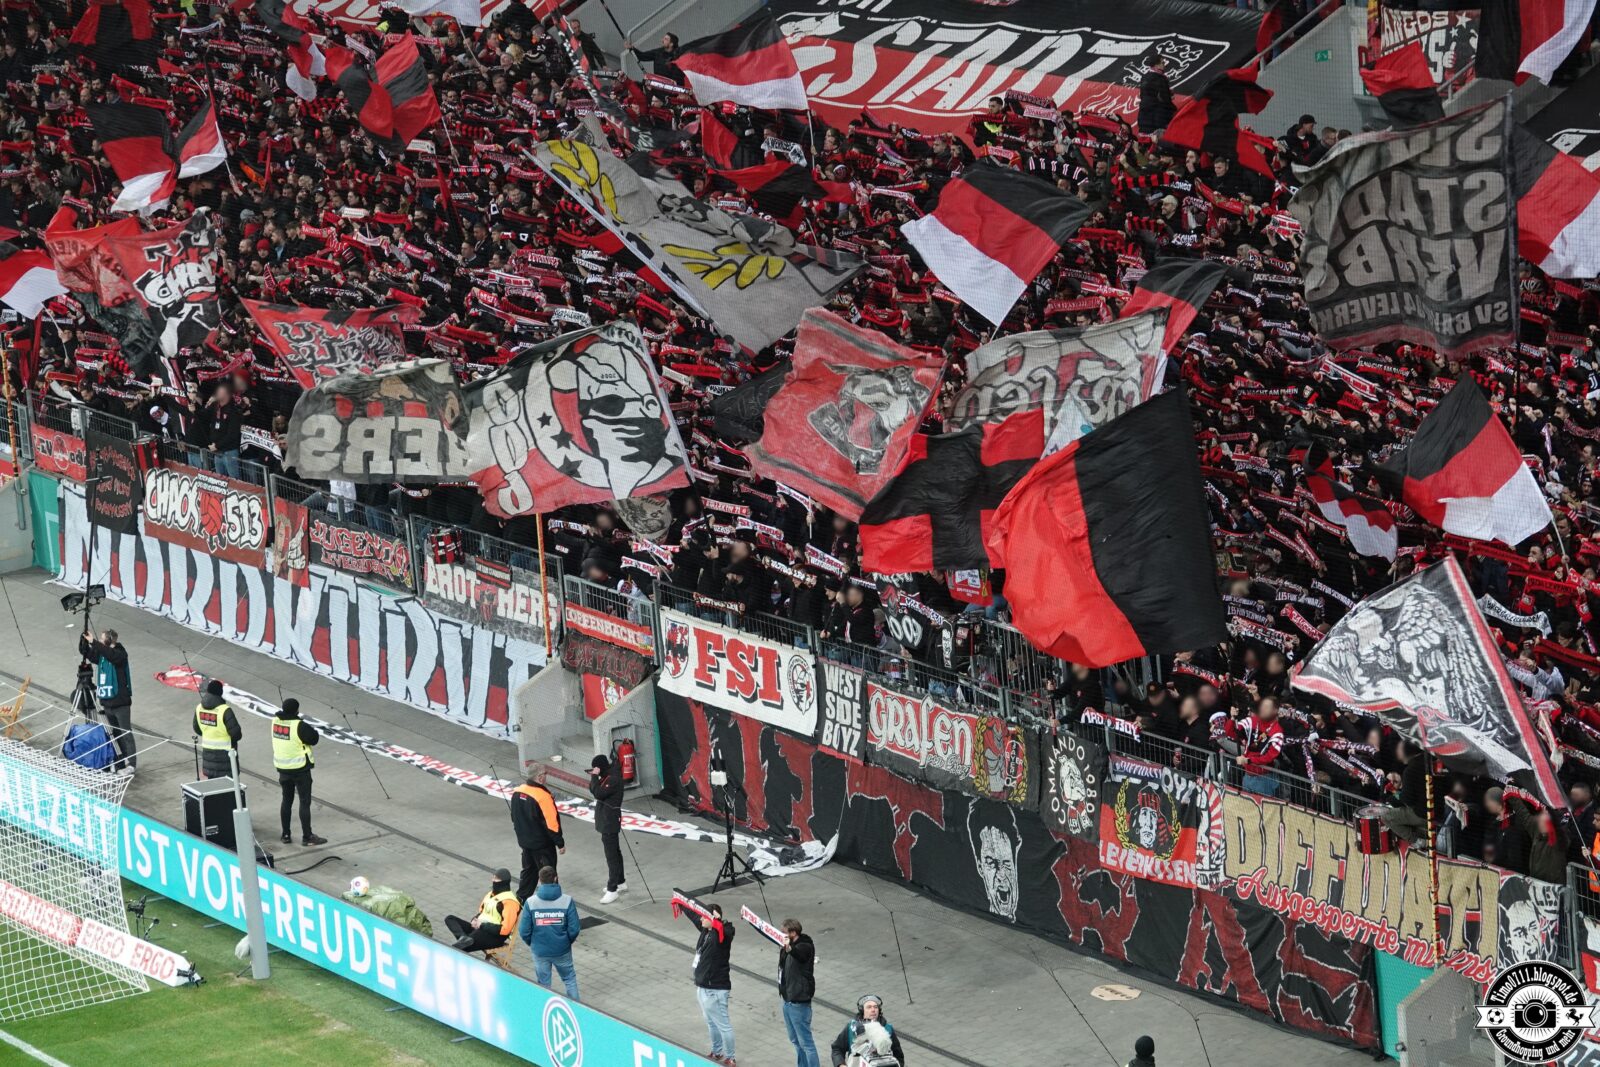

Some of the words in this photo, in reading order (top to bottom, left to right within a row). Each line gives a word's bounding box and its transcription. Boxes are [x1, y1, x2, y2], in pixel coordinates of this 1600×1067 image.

[806, 20, 1154, 112] STADT
[225, 490, 265, 550] 513
[310, 519, 394, 567] JUGEND
[693, 626, 783, 709] FSI
[823, 663, 862, 700] WEST
[822, 719, 861, 757] BOYZ
[825, 691, 862, 730] SIDE
[1049, 735, 1085, 825] COMMANDO
[1084, 763, 1097, 814] 1980
[122, 817, 170, 886] IST
[1099, 840, 1197, 885] LEVERKUSEN
[534, 910, 565, 919] Barmenia
[1236, 866, 1400, 955] Ausgesperrte
[81, 920, 126, 958] ERGO
[130, 938, 176, 981] ERGO
